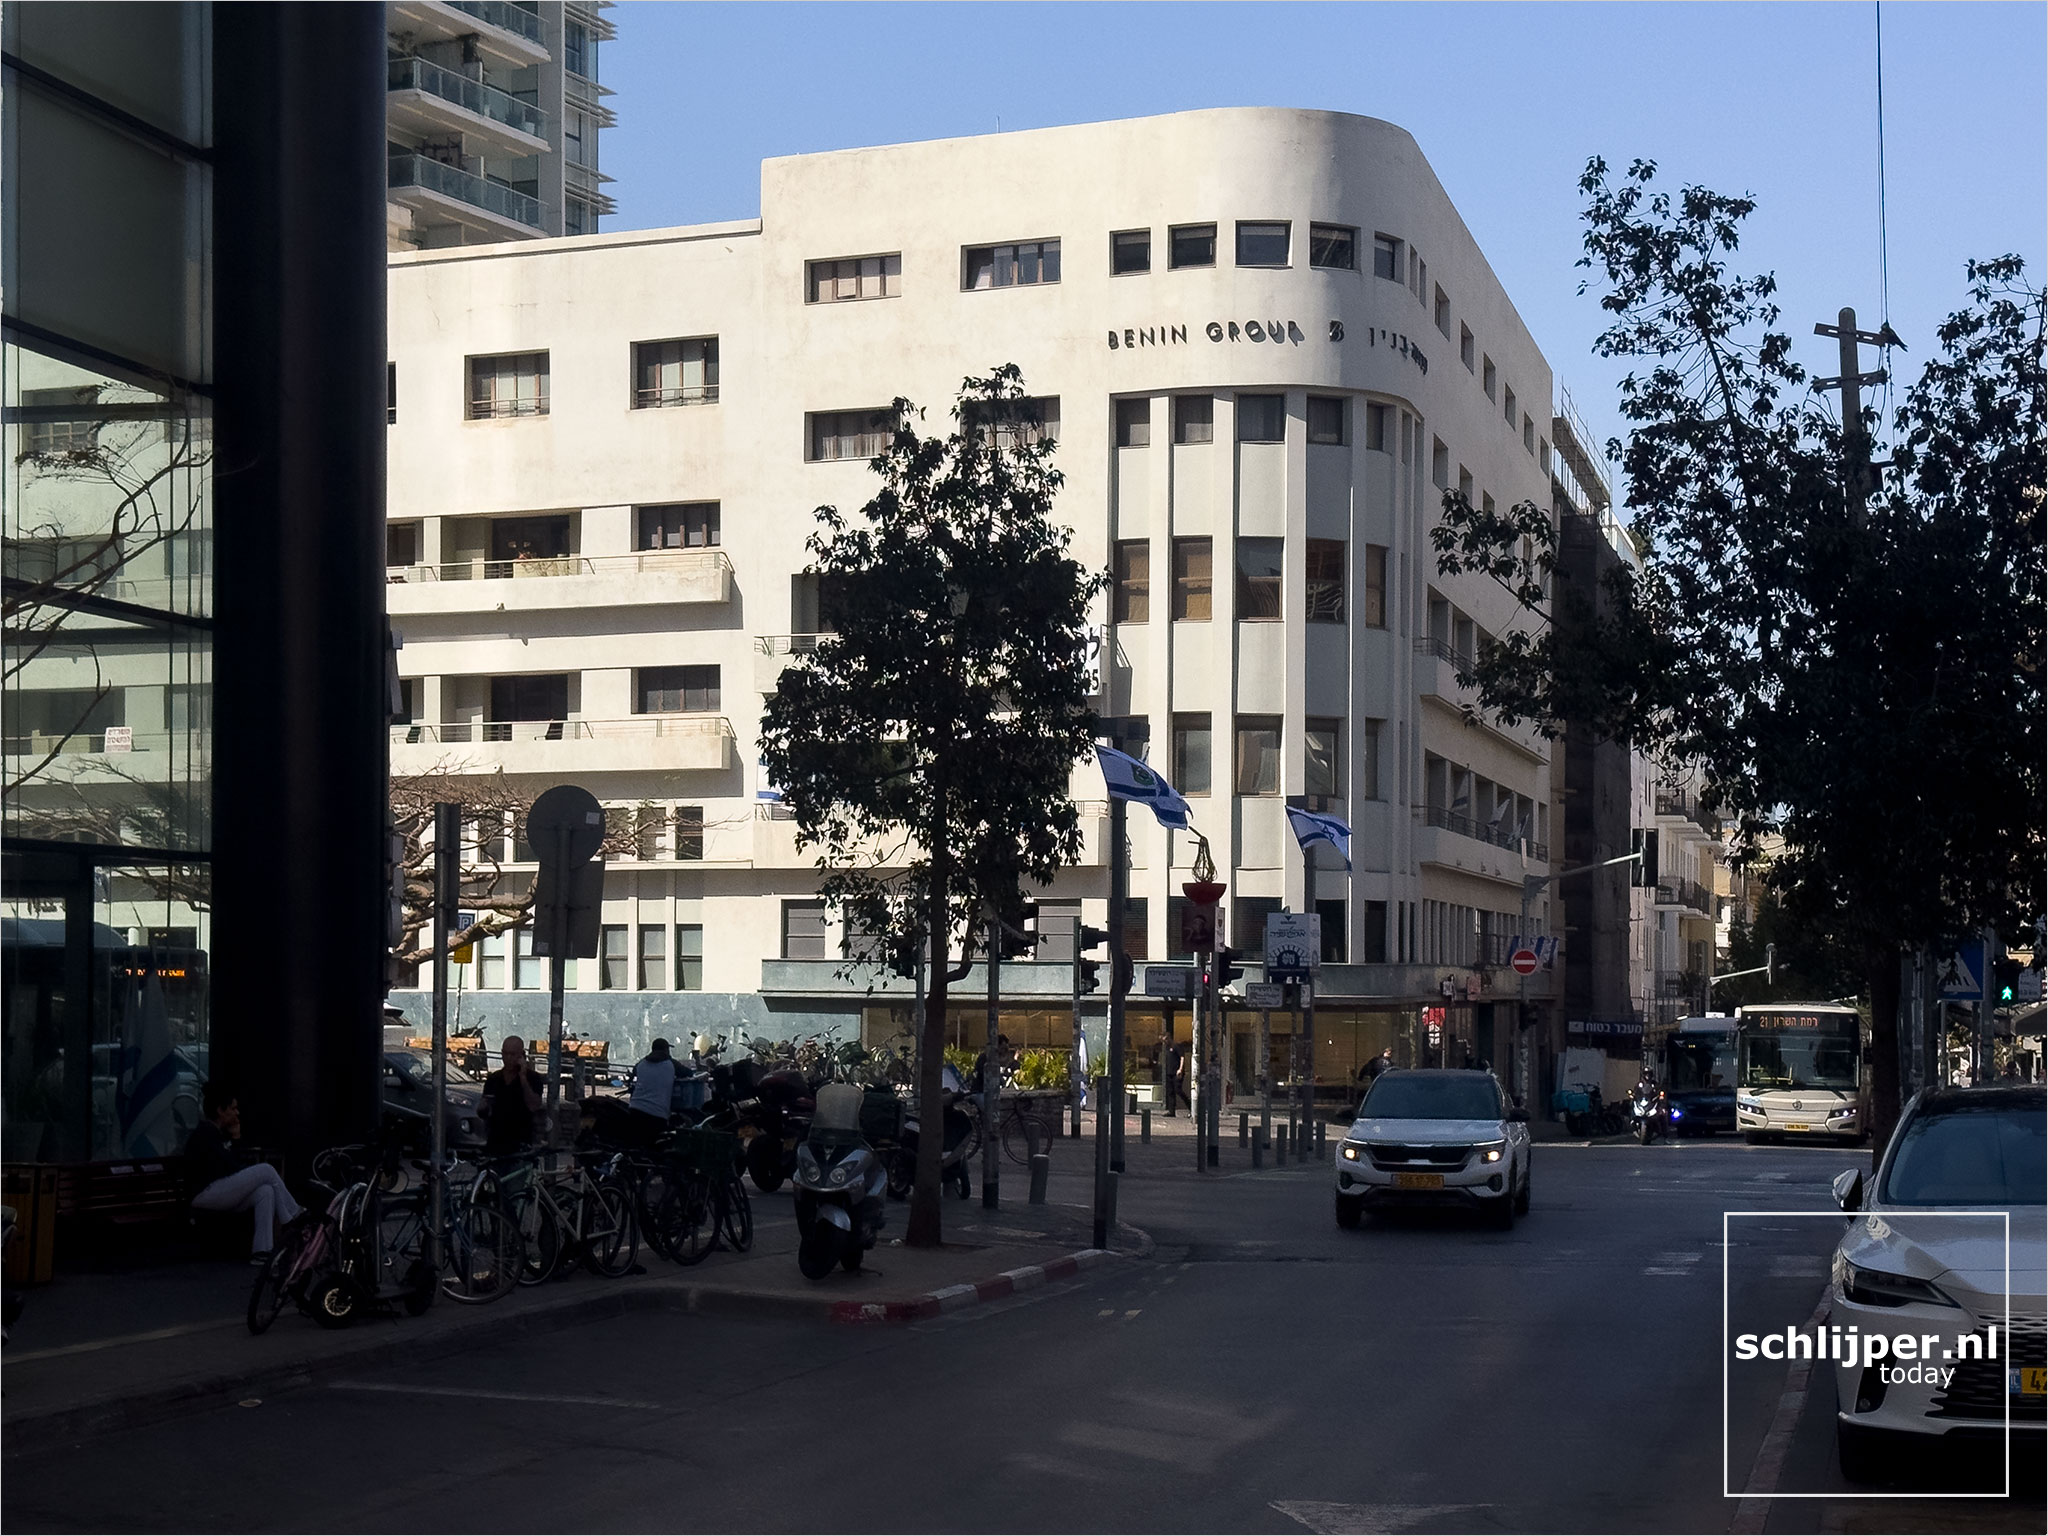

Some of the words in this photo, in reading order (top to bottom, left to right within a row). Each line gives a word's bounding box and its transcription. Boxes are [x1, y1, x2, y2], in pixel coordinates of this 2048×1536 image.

[1108, 323, 1188, 350] BENIN
[1205, 320, 1305, 347] GROUP
[1760, 1016, 1768, 1027] 21
[1773, 1016, 1796, 1027] השרון
[1800, 1016, 1818, 1027] רמת
[1585, 1022, 1611, 1033] בטוח
[1616, 1023, 1643, 1034] מעבר
